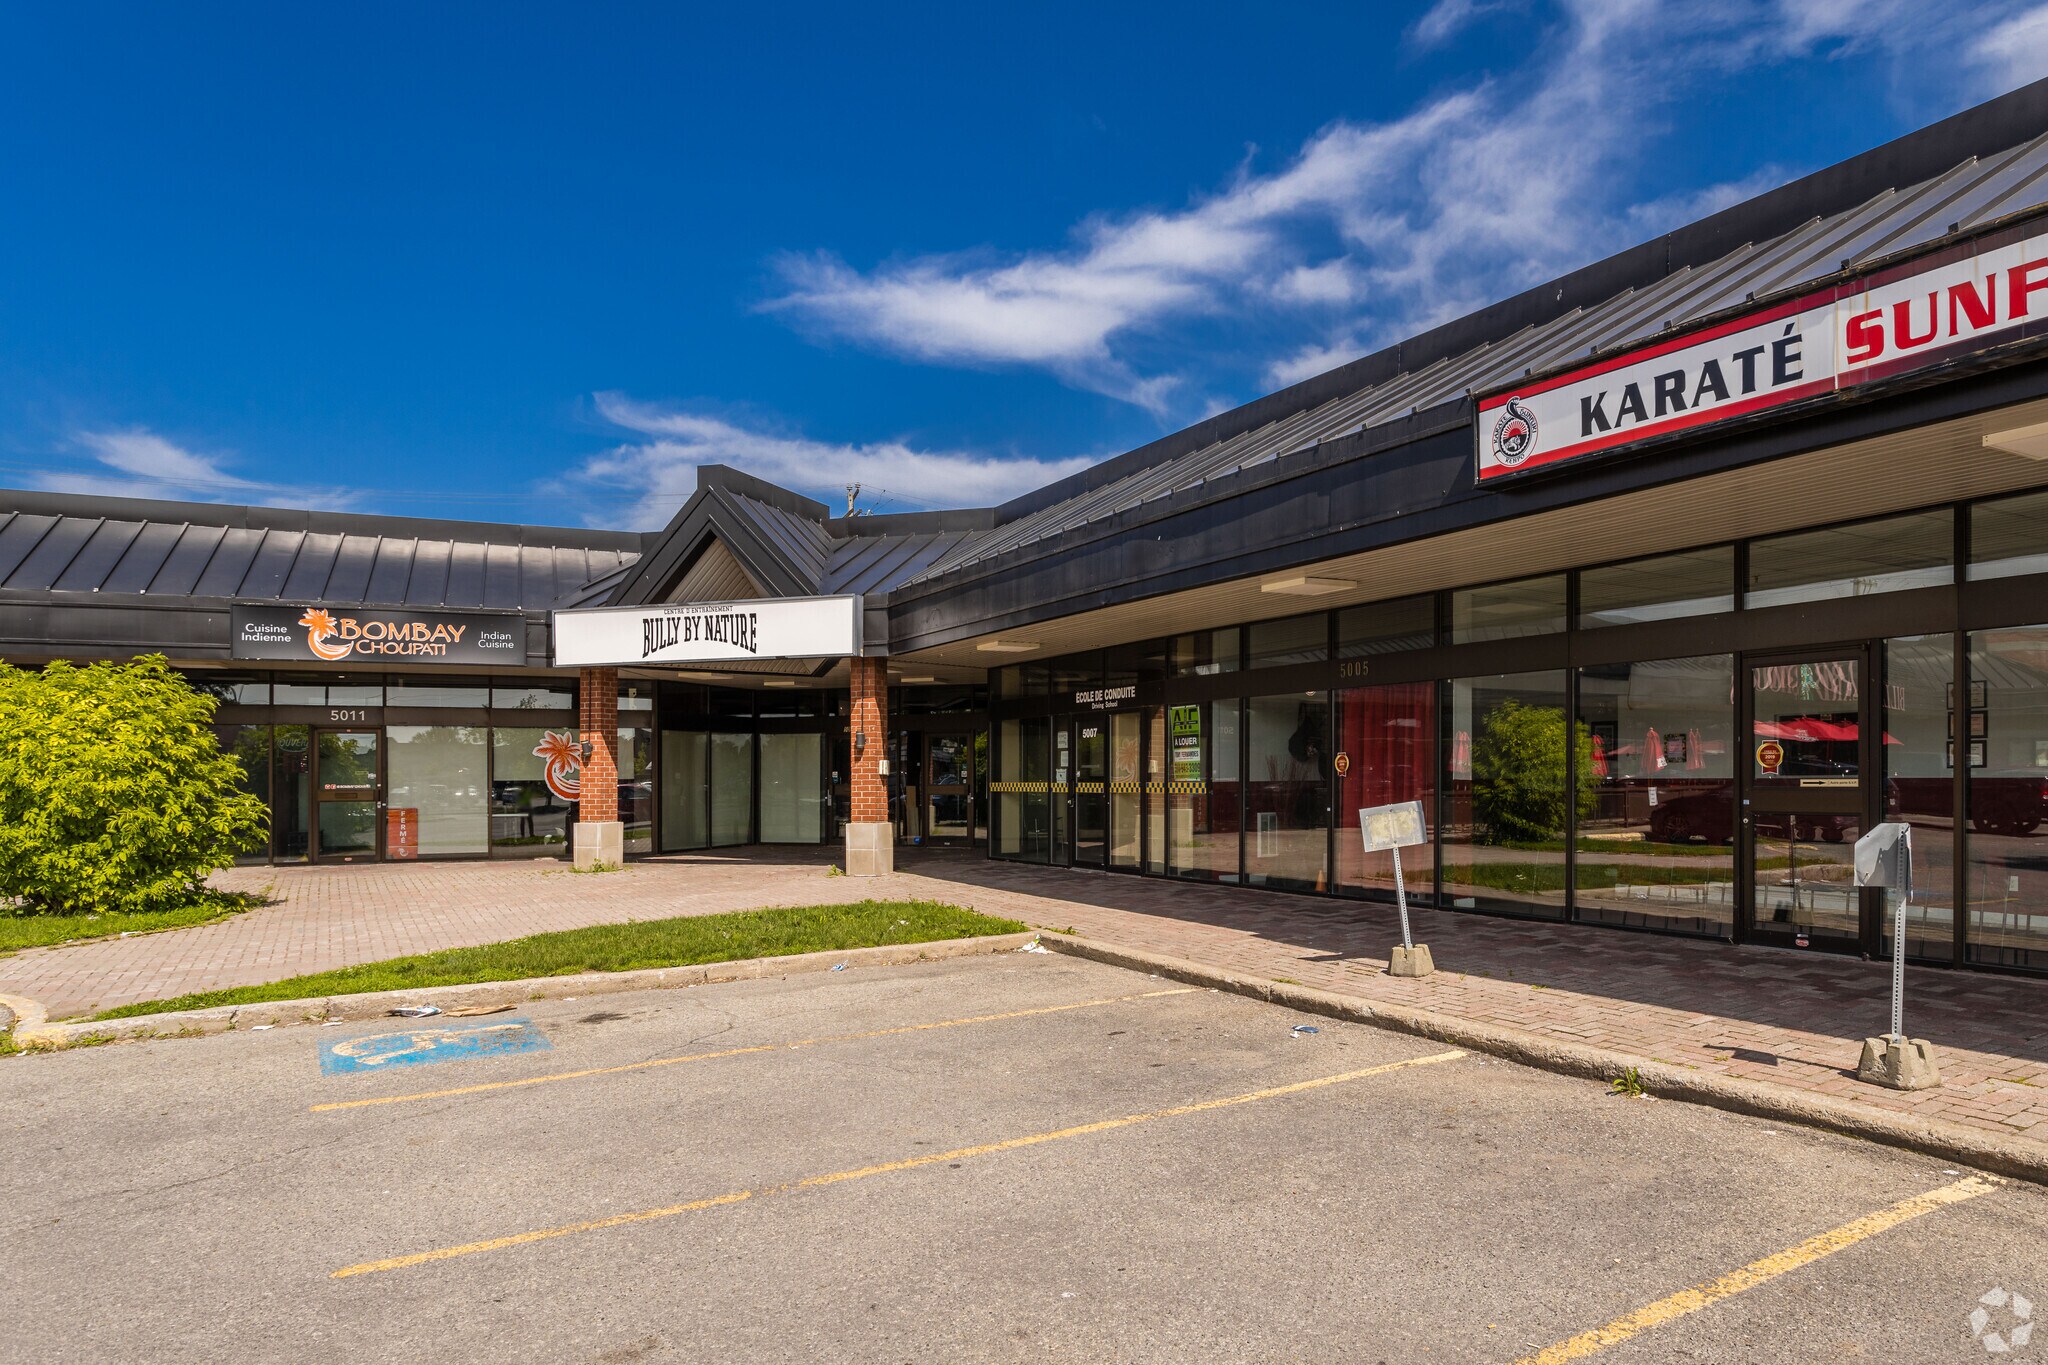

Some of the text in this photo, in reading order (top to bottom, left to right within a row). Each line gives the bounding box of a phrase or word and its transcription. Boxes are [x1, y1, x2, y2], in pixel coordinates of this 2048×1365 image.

[1580, 322, 1803, 437] KARATÉ
[664, 607, 684, 615] CENTRE
[245, 623, 288, 633] Cuisine
[339, 618, 467, 643] BOMBAY
[241, 632, 292, 643] Indienne
[480, 631, 512, 641] Indian
[642, 613, 757, 658] BULLY BY NATURE
[355, 639, 447, 656] CHOUPATI
[478, 639, 514, 649] Cuisine
[1340, 661, 1369, 678] 5005
[1095, 690, 1103, 701] DE
[1104, 686, 1136, 700] CONDUITE
[1105, 700, 1118, 708] School
[330, 710, 365, 721] 5011
[1082, 728, 1098, 738] 5007
[1179, 737, 1198, 746] LOUER
[399, 810, 407, 844] FERMÉ
